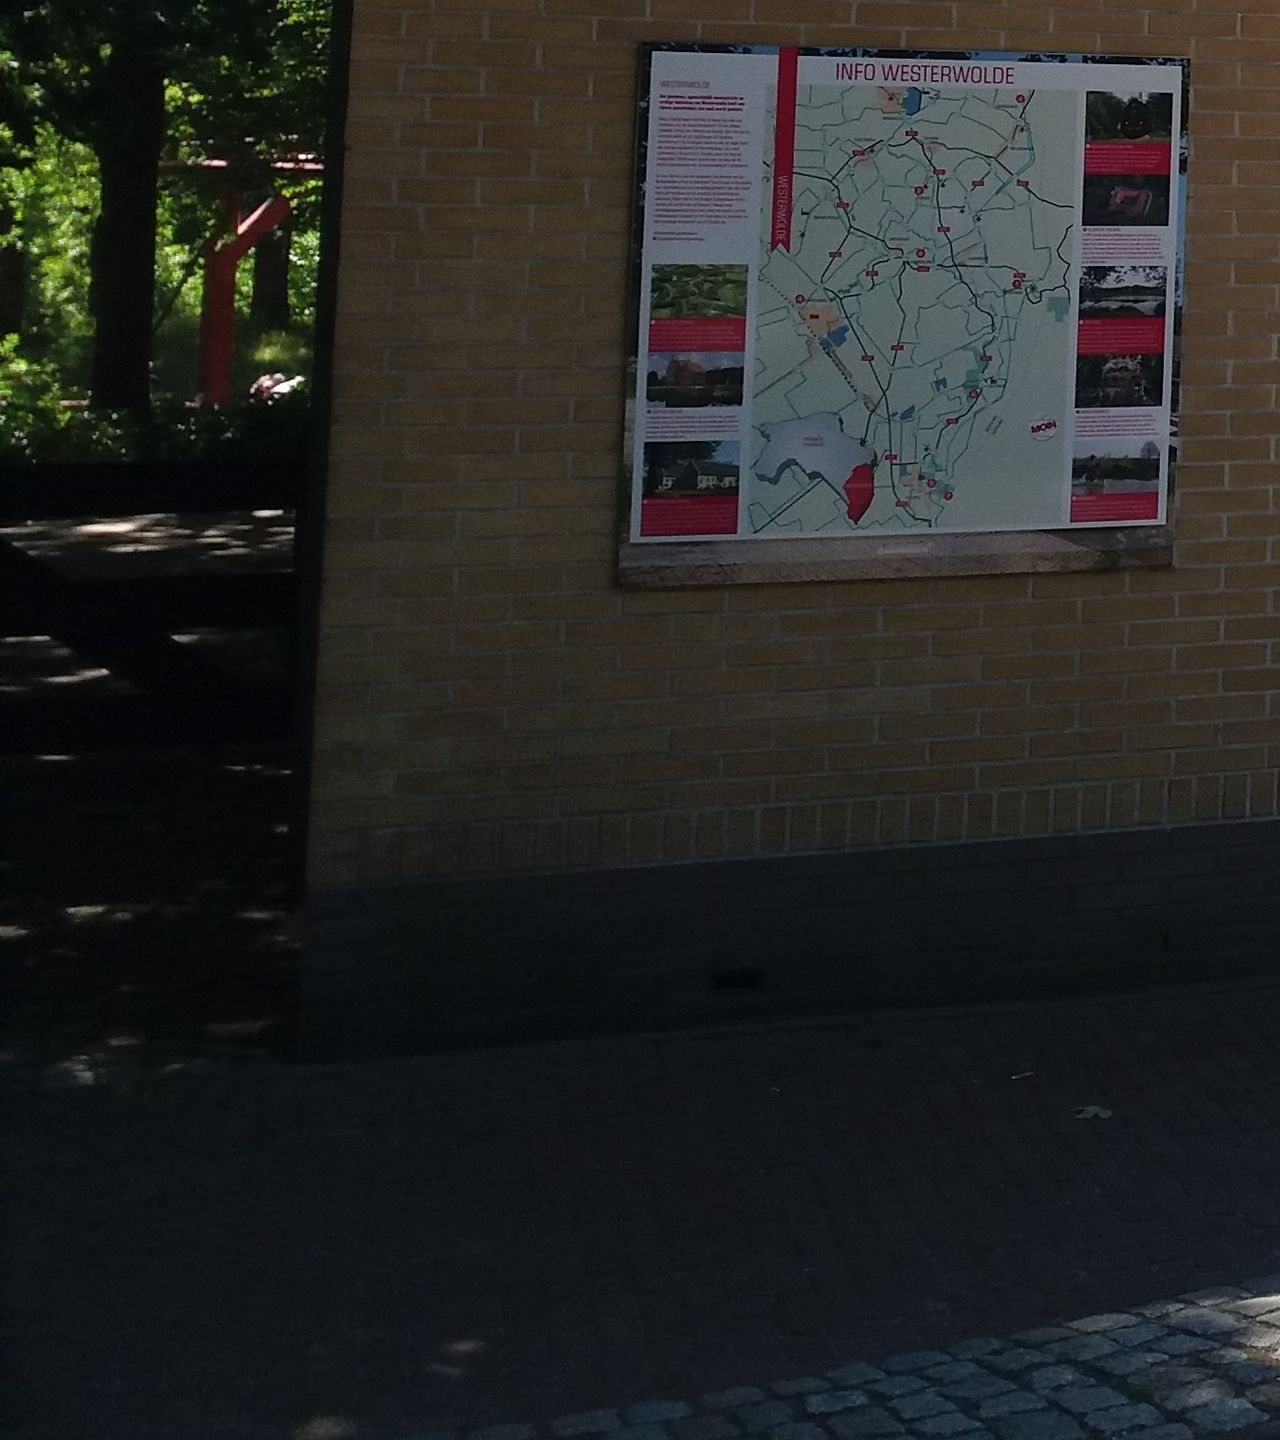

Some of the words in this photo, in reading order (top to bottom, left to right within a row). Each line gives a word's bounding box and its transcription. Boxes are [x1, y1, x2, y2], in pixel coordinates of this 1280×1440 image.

[836, 63, 876, 81] INFO
[882, 64, 1015, 84] WESTERWOLDE
[775, 175, 789, 241] WESTERWOLDE
